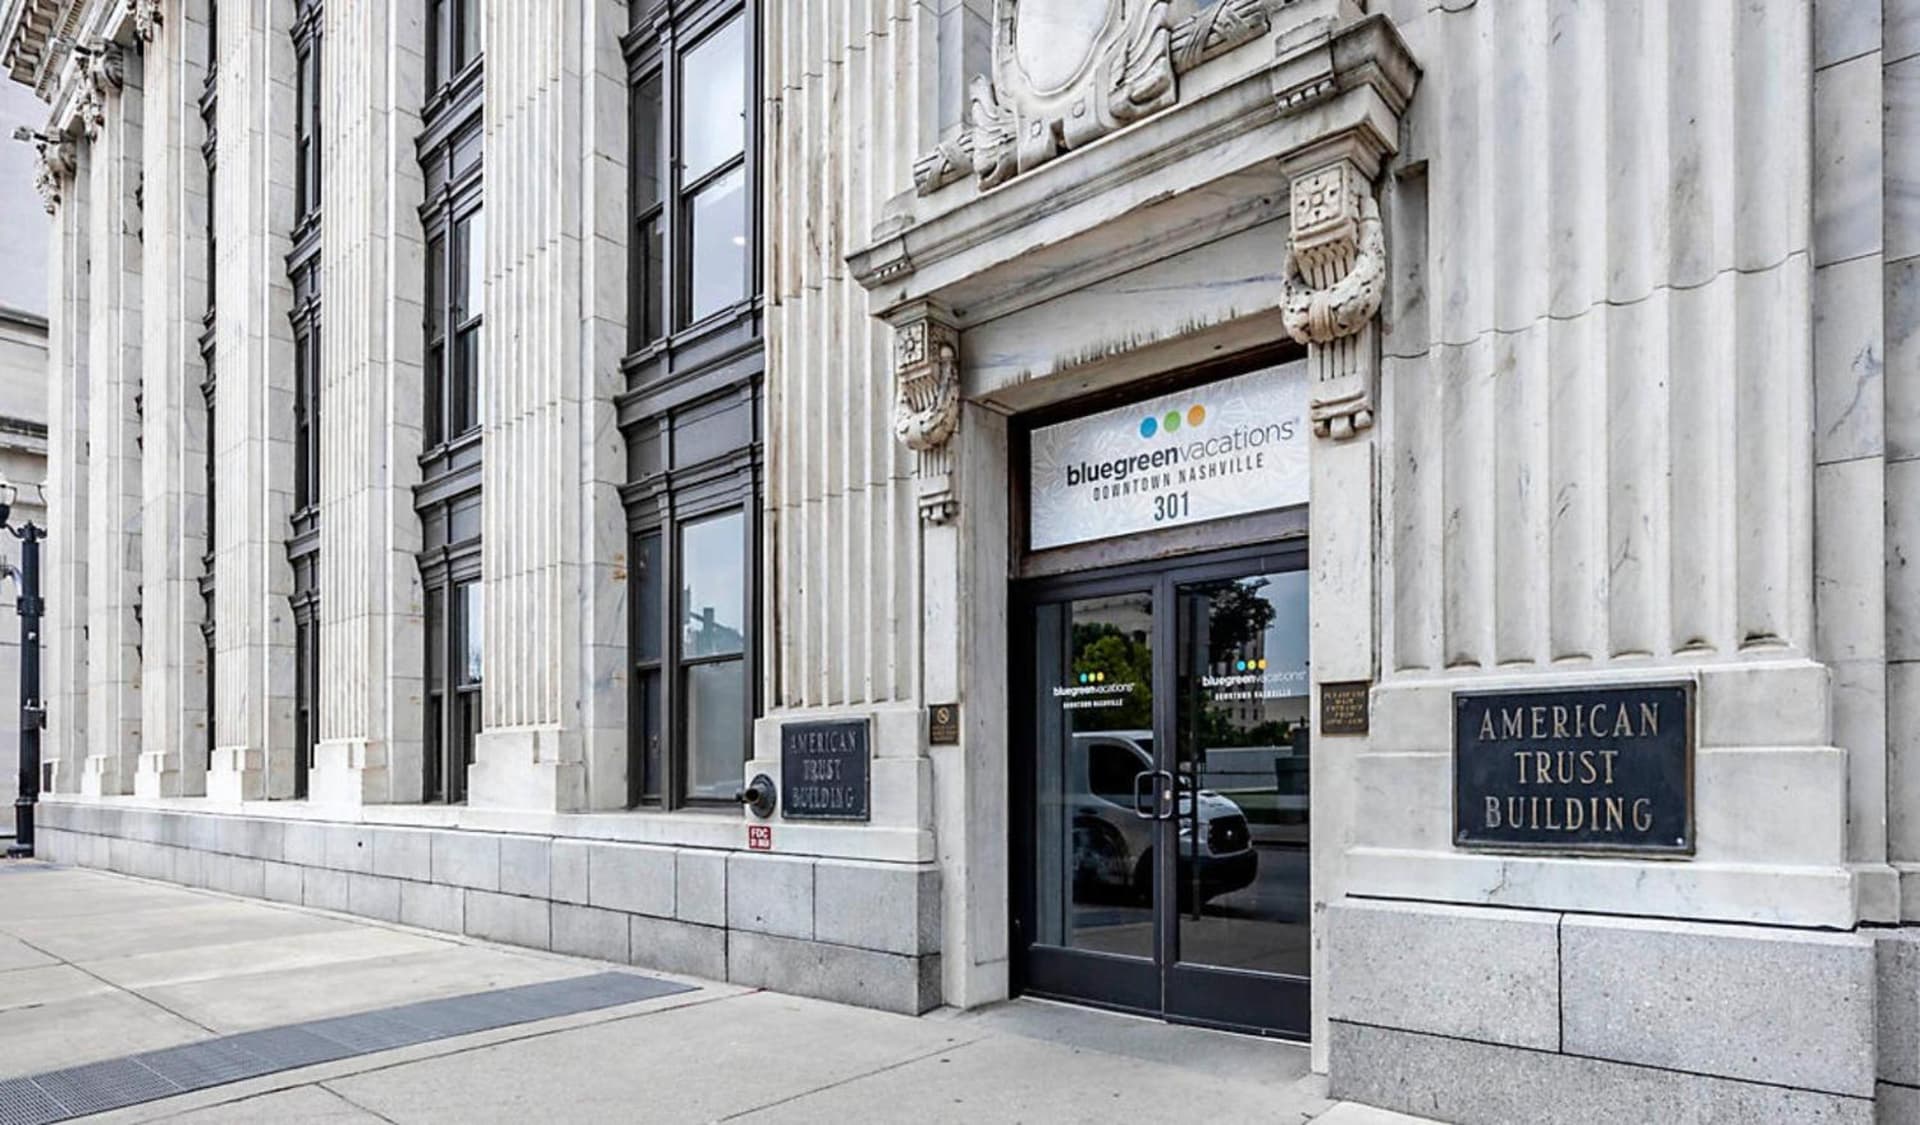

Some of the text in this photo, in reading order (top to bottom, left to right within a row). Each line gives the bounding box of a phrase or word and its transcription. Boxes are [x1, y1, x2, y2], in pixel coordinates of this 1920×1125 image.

[1093, 452, 1264, 501] DOWNTOWN NASHVILLE
[1153, 491, 1189, 521] 301
[1479, 702, 1659, 741] AMERICAN
[790, 731, 856, 753] AMERICAN
[803, 759, 842, 781] TRUST
[1514, 750, 1619, 784] TRUST
[792, 787, 854, 809] BUILDING
[1485, 796, 1652, 832] BUILDING
[751, 828, 769, 839] FDC
